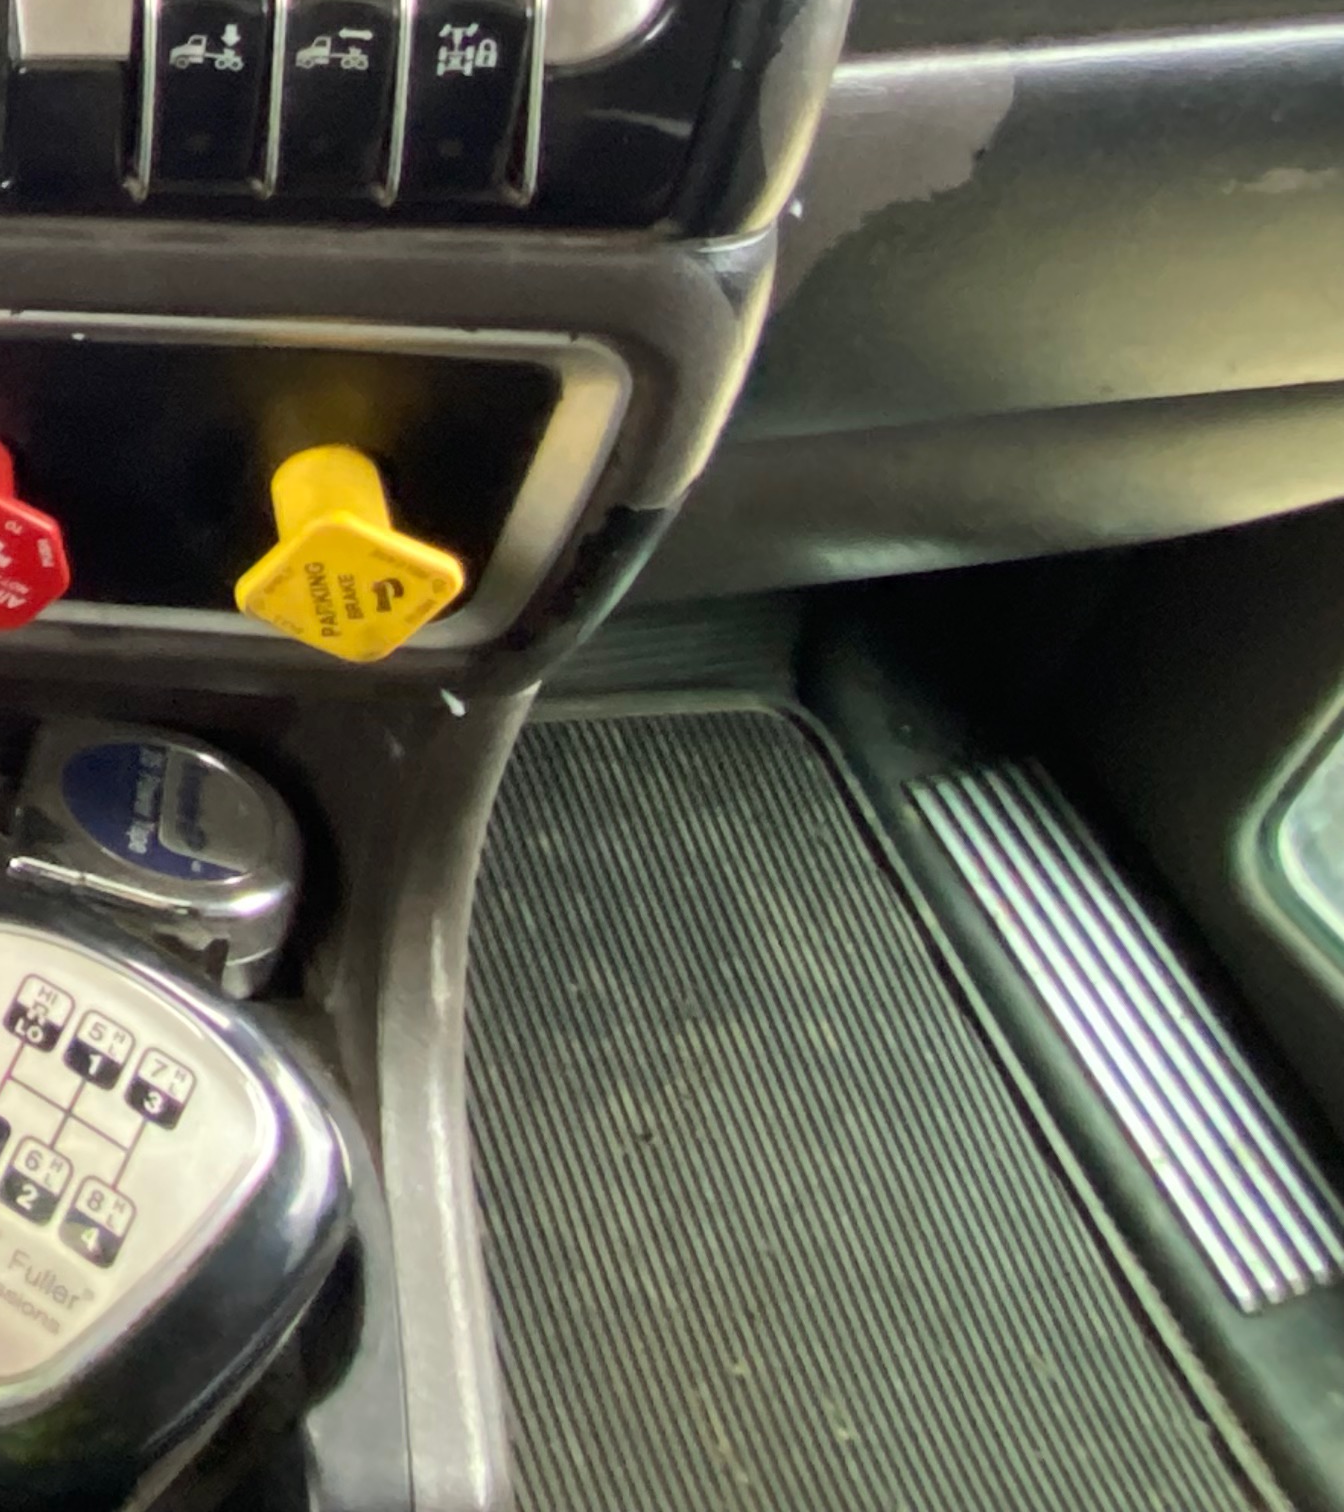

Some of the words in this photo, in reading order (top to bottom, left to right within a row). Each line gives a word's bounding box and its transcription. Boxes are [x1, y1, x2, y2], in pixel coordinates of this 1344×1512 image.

[303, 561, 343, 639] PARKING
[337, 572, 365, 620] BRAKE
[37, 985, 60, 1007] HI
[15, 1019, 45, 1042] LO
[87, 1022, 107, 1043] 5
[84, 1050, 103, 1074] 1
[148, 1059, 170, 1081] 7
[142, 1091, 163, 1115] 3
[23, 1148, 42, 1171] 6
[15, 1188, 38, 1211] 2
[86, 1188, 104, 1213] 8
[80, 1227, 100, 1251] 4
